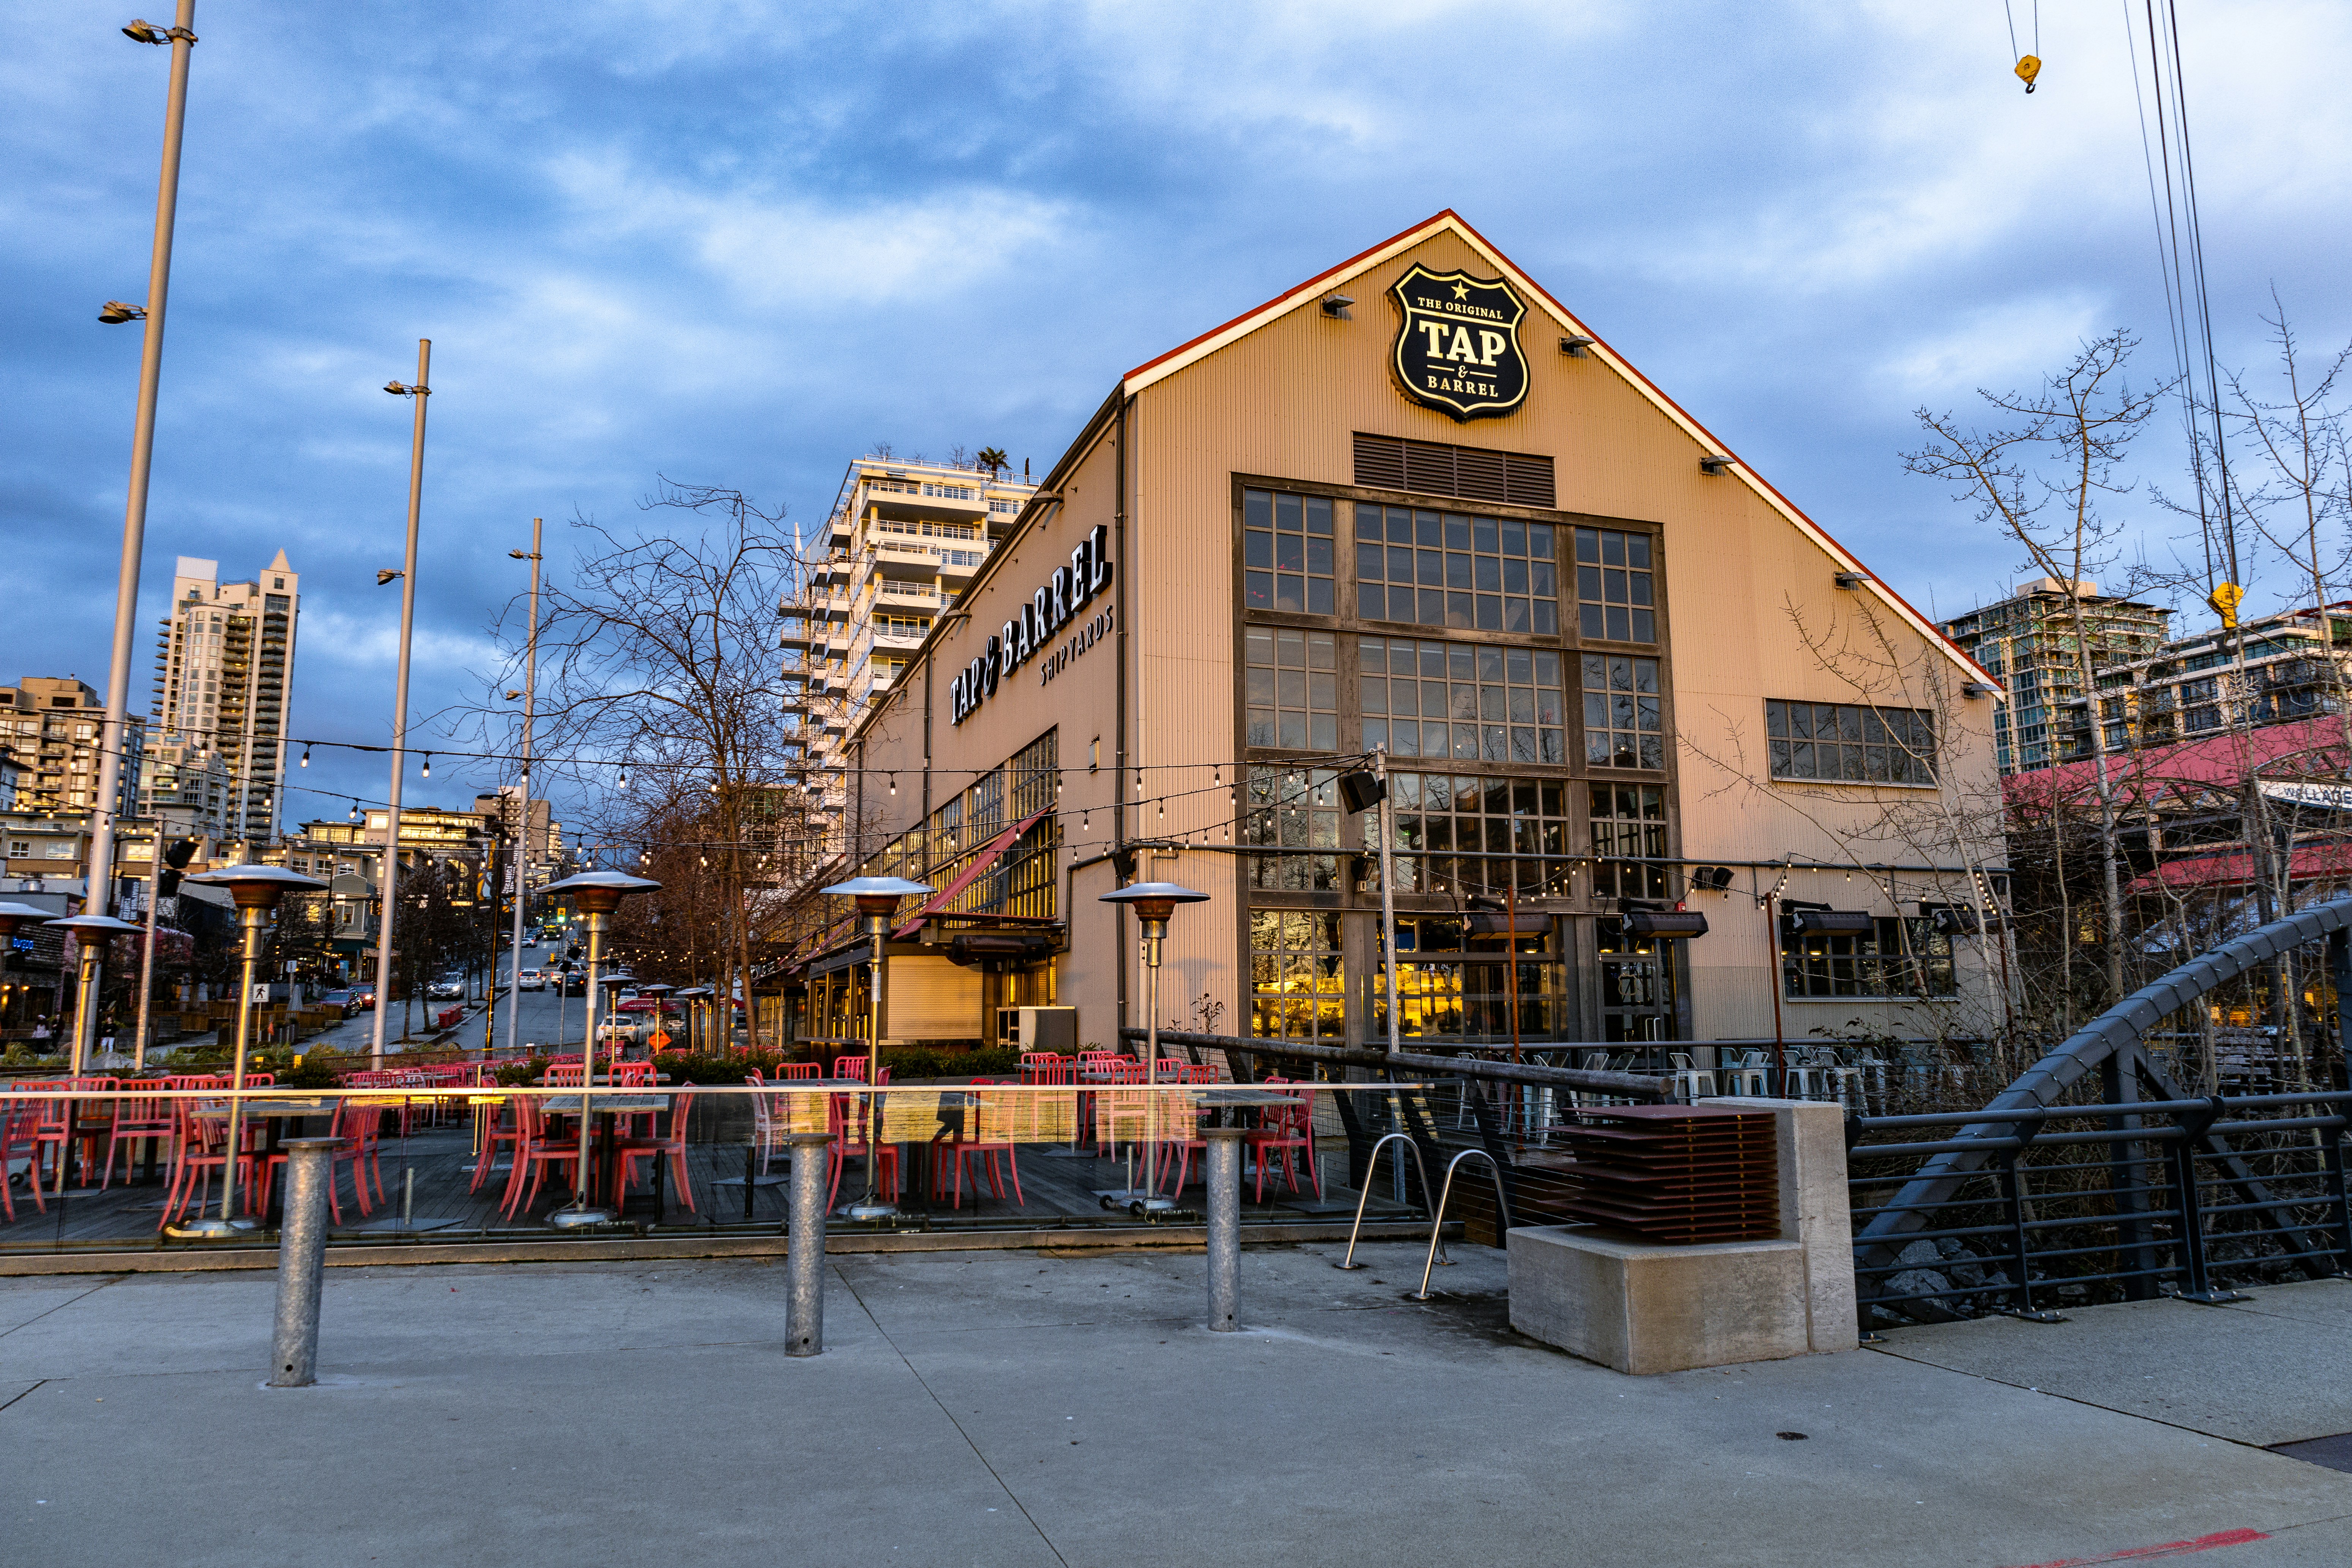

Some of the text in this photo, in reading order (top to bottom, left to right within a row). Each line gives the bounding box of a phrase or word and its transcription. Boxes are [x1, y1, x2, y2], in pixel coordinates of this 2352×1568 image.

[1418, 297, 1503, 319] THE ORIGINAL
[1419, 320, 1506, 366] TAP
[1427, 375, 1498, 397] BARREL
[1458, 365, 1468, 378] &
[950, 525, 1113, 726] TAP & BARREL
[1040, 605, 1113, 686] SHIPYARDS
